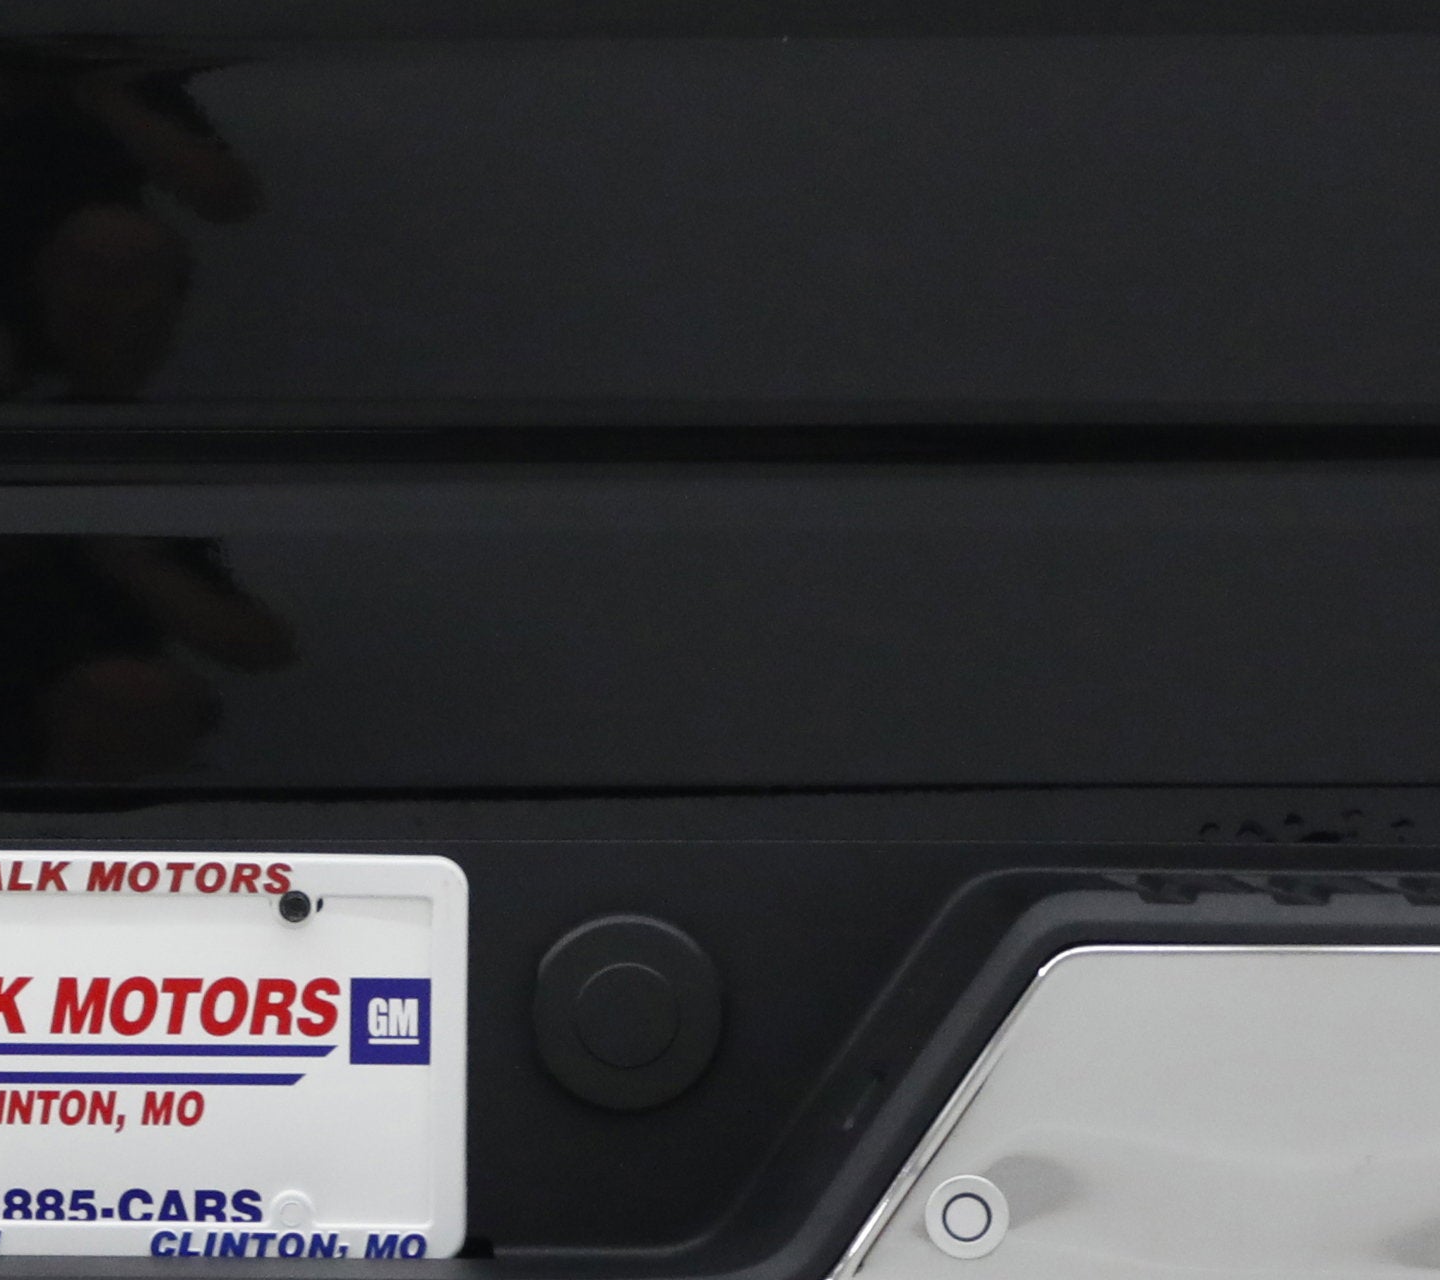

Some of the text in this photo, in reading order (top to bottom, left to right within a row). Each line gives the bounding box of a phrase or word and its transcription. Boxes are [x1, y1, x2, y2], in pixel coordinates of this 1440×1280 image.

[85, 861, 294, 895] MOTORS
[49, 976, 342, 1038] MOTORS
[366, 996, 421, 1038] GM
[140, 1090, 206, 1127] MO
[149, 1230, 428, 1259] CLINTON, MO
